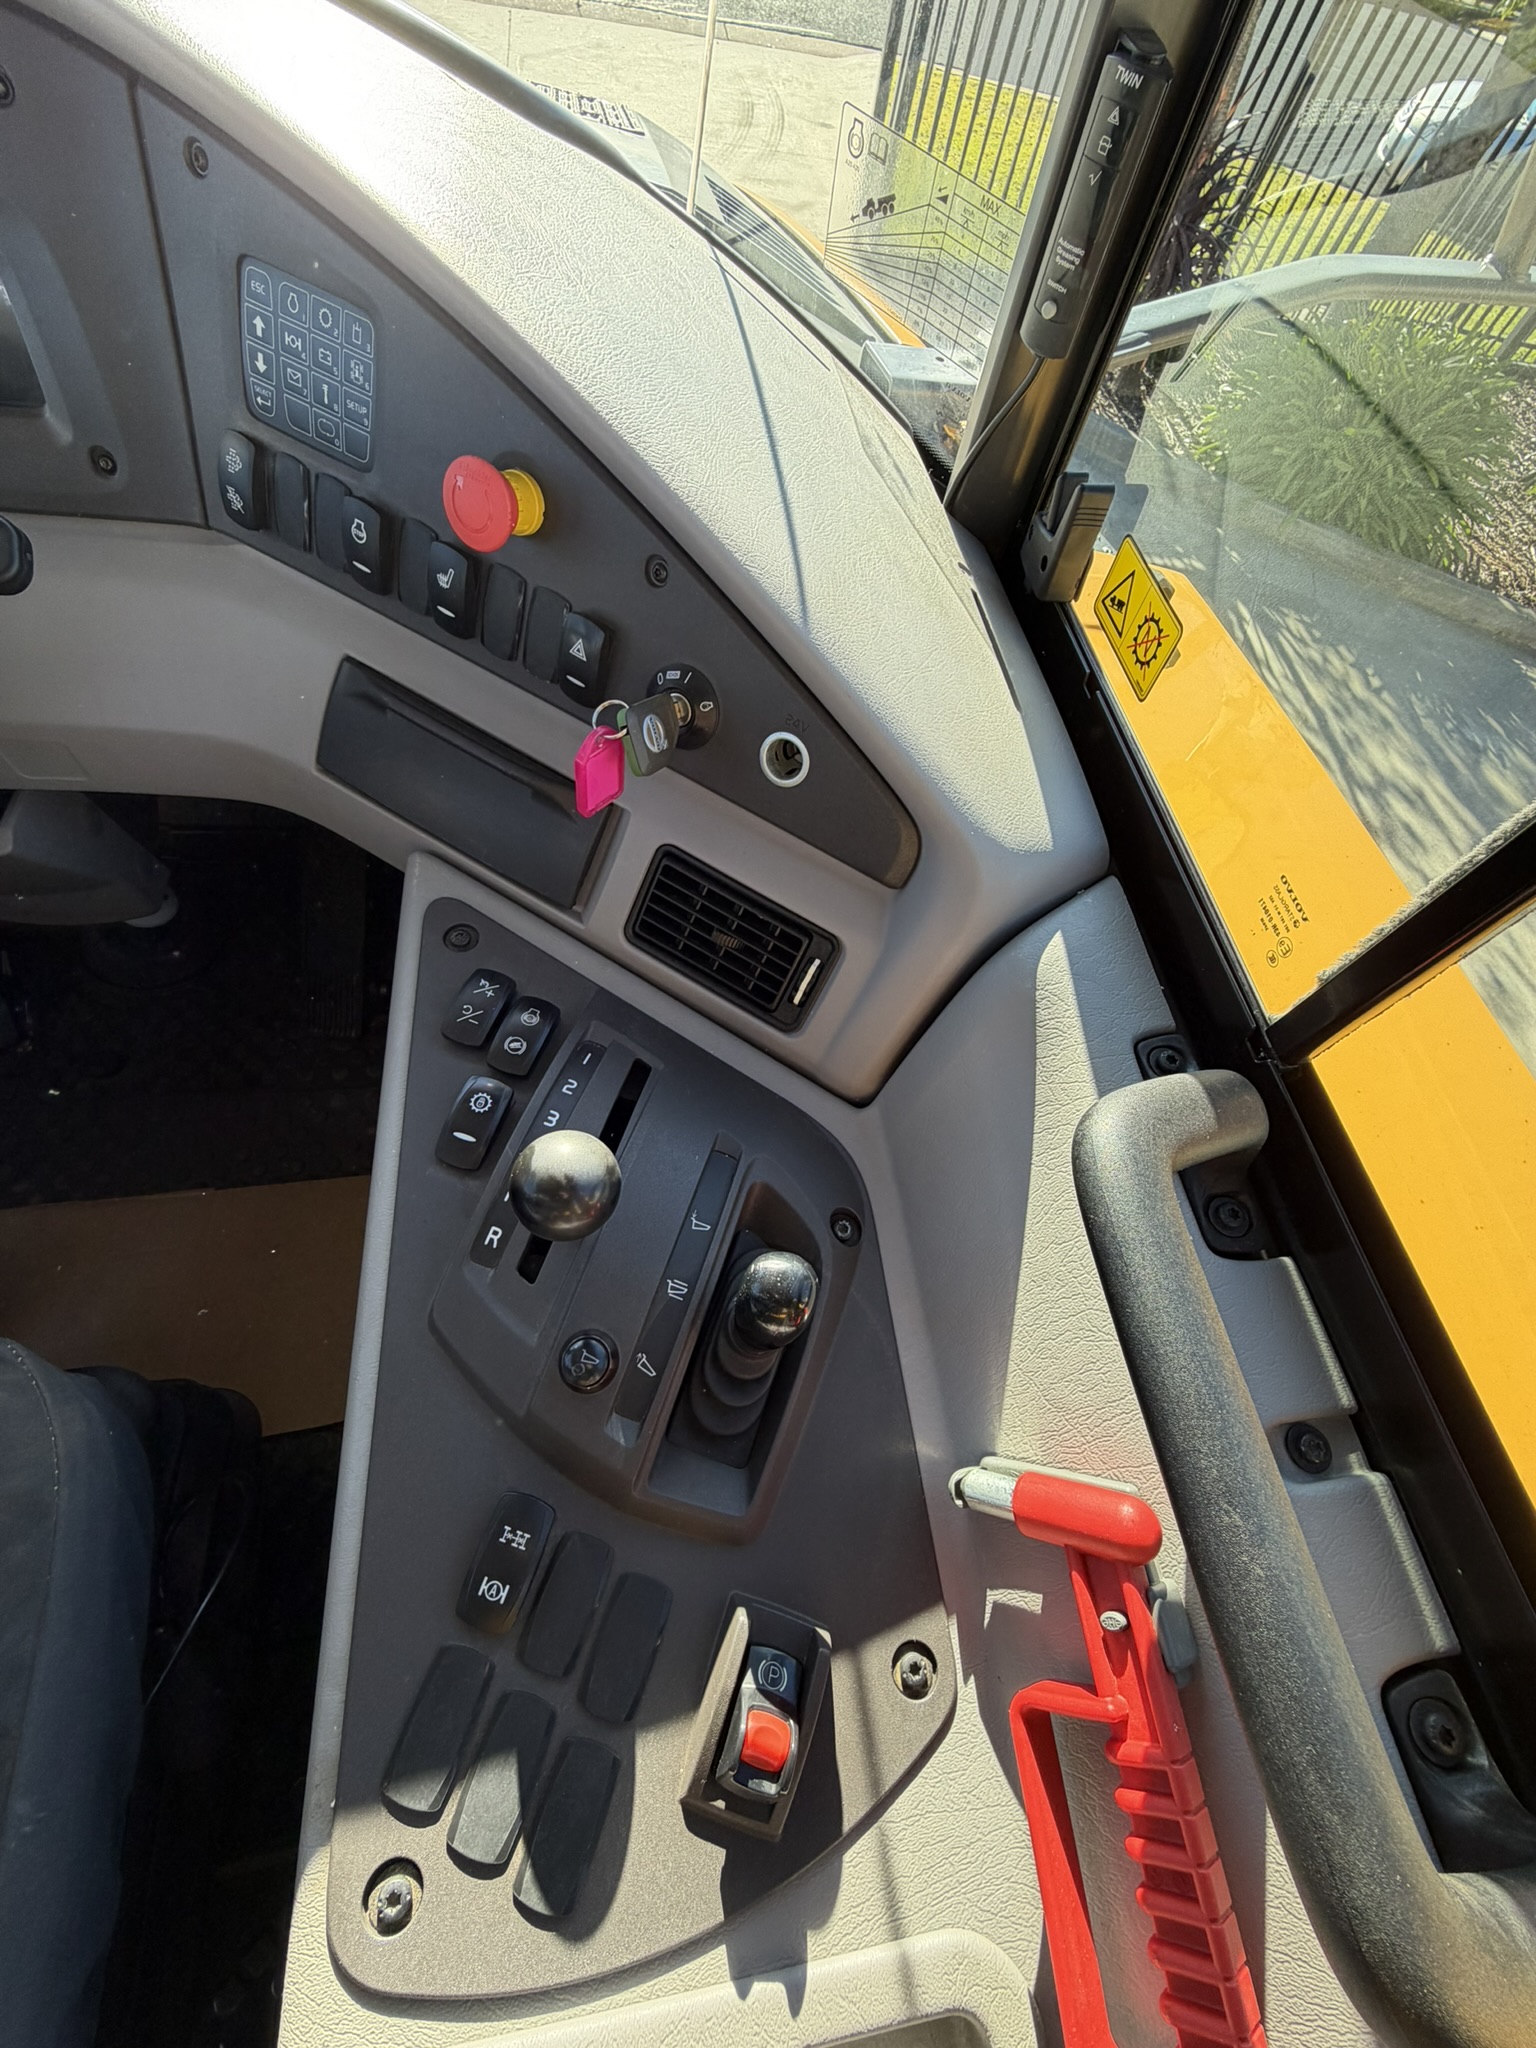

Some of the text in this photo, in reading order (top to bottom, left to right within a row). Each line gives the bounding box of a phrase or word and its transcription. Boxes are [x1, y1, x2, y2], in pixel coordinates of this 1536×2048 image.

[1115, 64, 1144, 89] TWIN
[980, 195, 1002, 217] MAX
[1058, 236, 1085, 257] Automatic
[1055, 255, 1075, 271] System
[1056, 245, 1080, 265] Greasing
[250, 280, 266, 296] ESC
[333, 328, 339, 338] 2
[301, 352, 306, 360] 4
[333, 367, 338, 376] 5
[254, 384, 272, 399] SELECT
[302, 388, 307, 396] 7
[365, 382, 370, 391] 6
[346, 399, 367, 415] SETUP
[582, 1052, 592, 1065] 1
[562, 1078, 578, 1095] 2
[543, 1110, 560, 1127] 3
[484, 1226, 503, 1249] R
[768, 1665, 780, 1684] P
